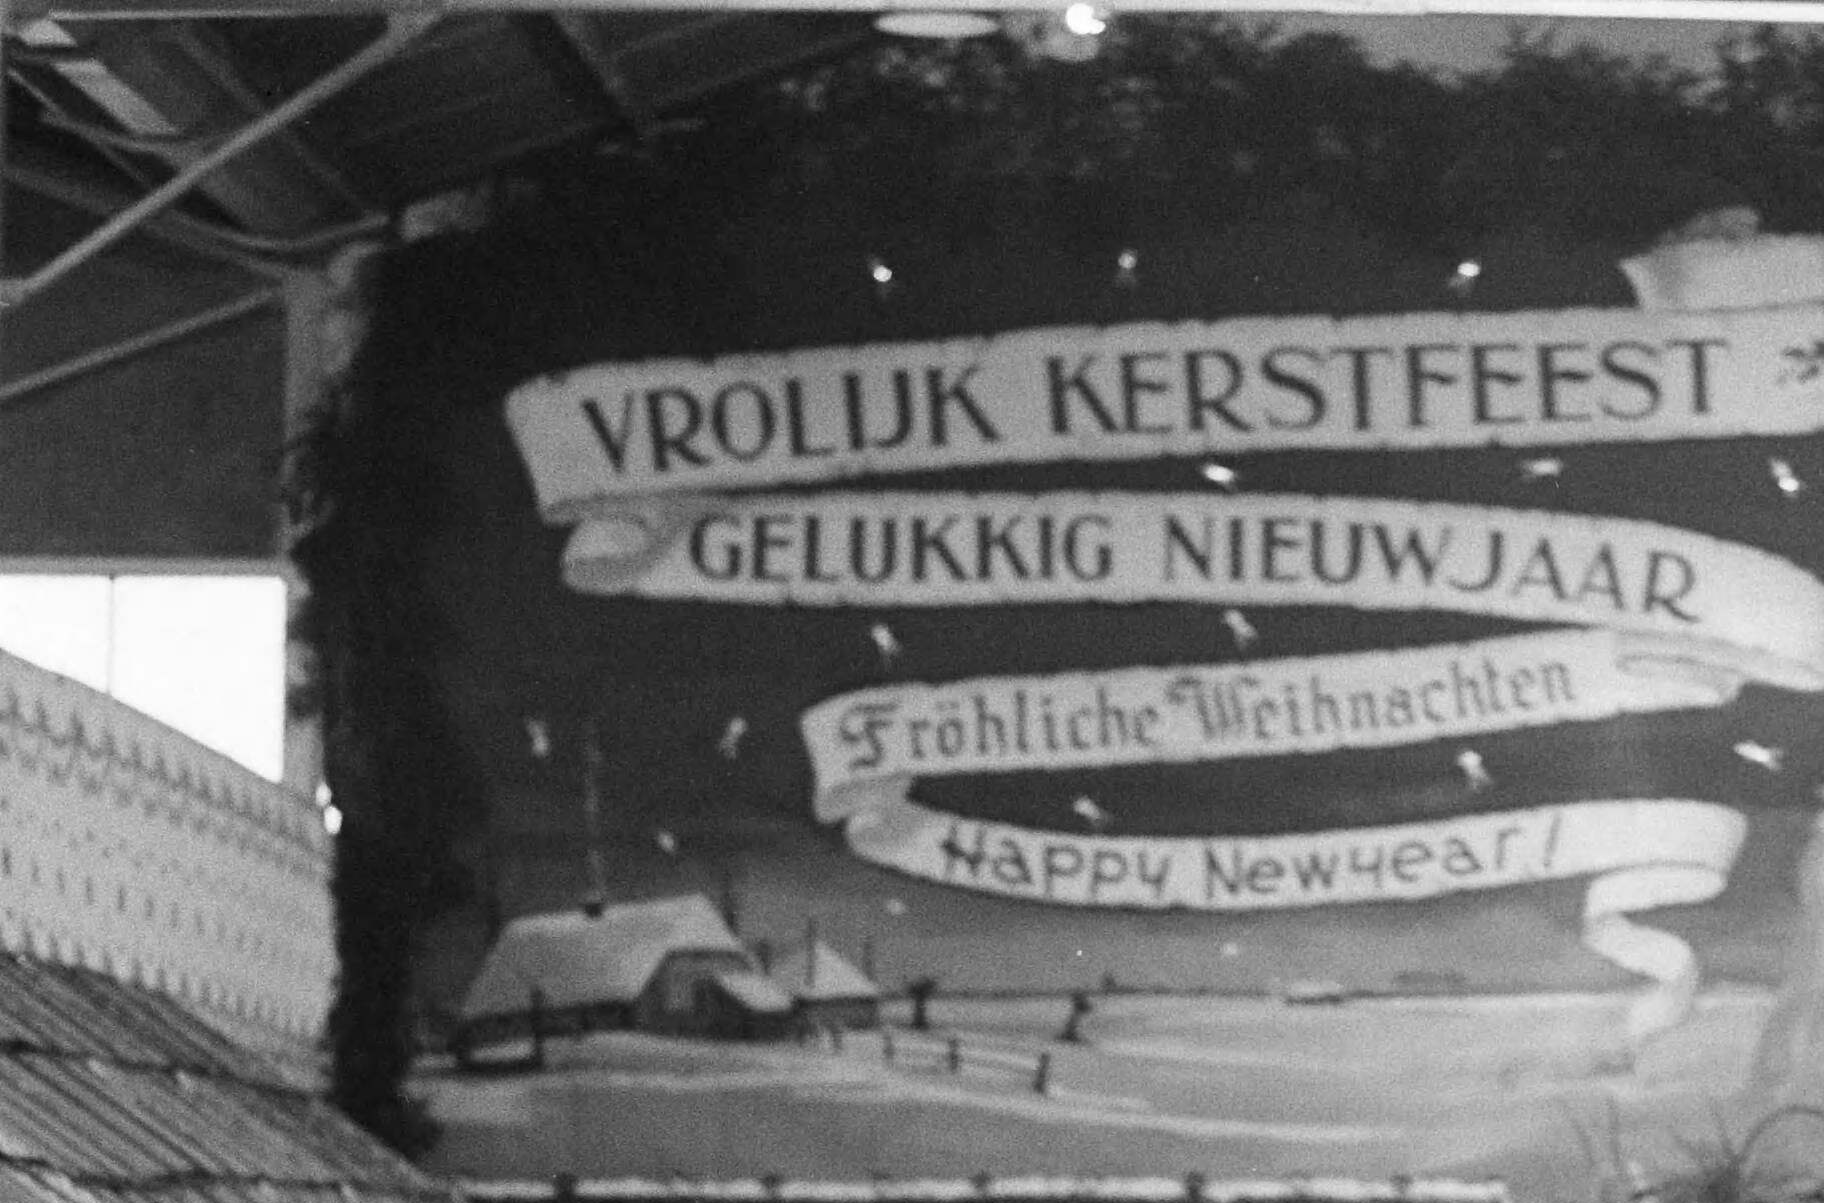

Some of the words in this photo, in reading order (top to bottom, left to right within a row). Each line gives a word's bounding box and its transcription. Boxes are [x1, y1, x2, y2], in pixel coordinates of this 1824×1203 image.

[579, 363, 1001, 475] VROLIJK
[1046, 338, 1732, 437] KERSTFEEST
[689, 513, 1113, 583] GELUKKIG
[1164, 515, 1701, 624] NIEUWJAAR
[839, 685, 1160, 770] Fröhliche
[1164, 657, 1576, 740] Weihnachten
[940, 824, 1170, 901] Happy
